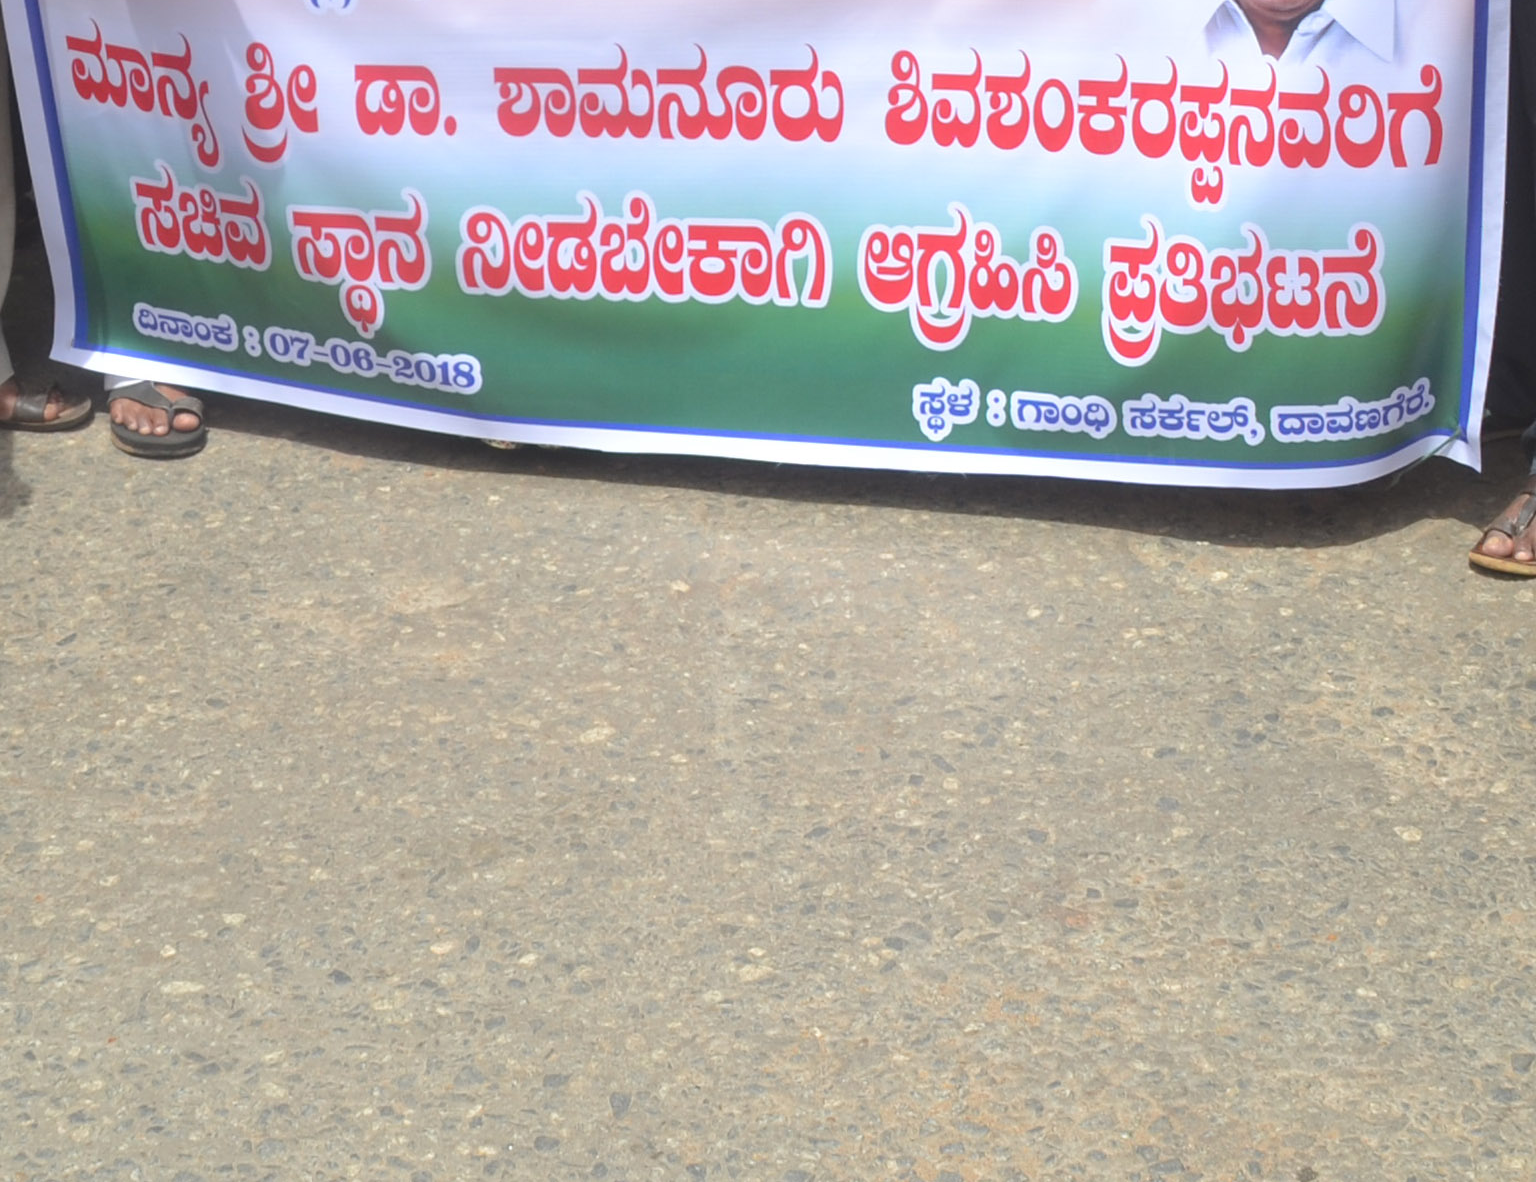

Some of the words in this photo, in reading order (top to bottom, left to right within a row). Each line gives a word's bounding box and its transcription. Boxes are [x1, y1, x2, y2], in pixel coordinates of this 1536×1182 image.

[65, 18, 220, 168] ಮಾನ್ಯ
[242, 41, 319, 163] ಶ್ರೀ
[354, 64, 457, 137] ಡಾ.
[493, 43, 844, 143] ಶಾಮನೂರು
[884, 47, 1444, 205] ಶಿವಶಂಕರಪ್ಪನವರಿಗೆ
[135, 165, 267, 265] ಸಚಿವ
[291, 192, 427, 333] ಸ್ಥಾನ
[462, 194, 826, 301] ನೀಡಬೇಕಾಗಿ
[864, 207, 1072, 344] ಆಗ್ರಹಿಸಿ
[1108, 219, 1379, 359] ಪ್ರತಿಭಟನೆ
[137, 307, 233, 346] ದಿನಾಂಕ
[269, 332, 476, 389] 07-06-2018
[918, 385, 974, 435] ಸ್ಥಳ
[1017, 395, 1112, 434] ಗಾಂಧಿ
[1129, 397, 1259, 441] ಸರ್ಕಲ್,
[1276, 384, 1430, 437] ದಾವಣಗೆರೆ.
